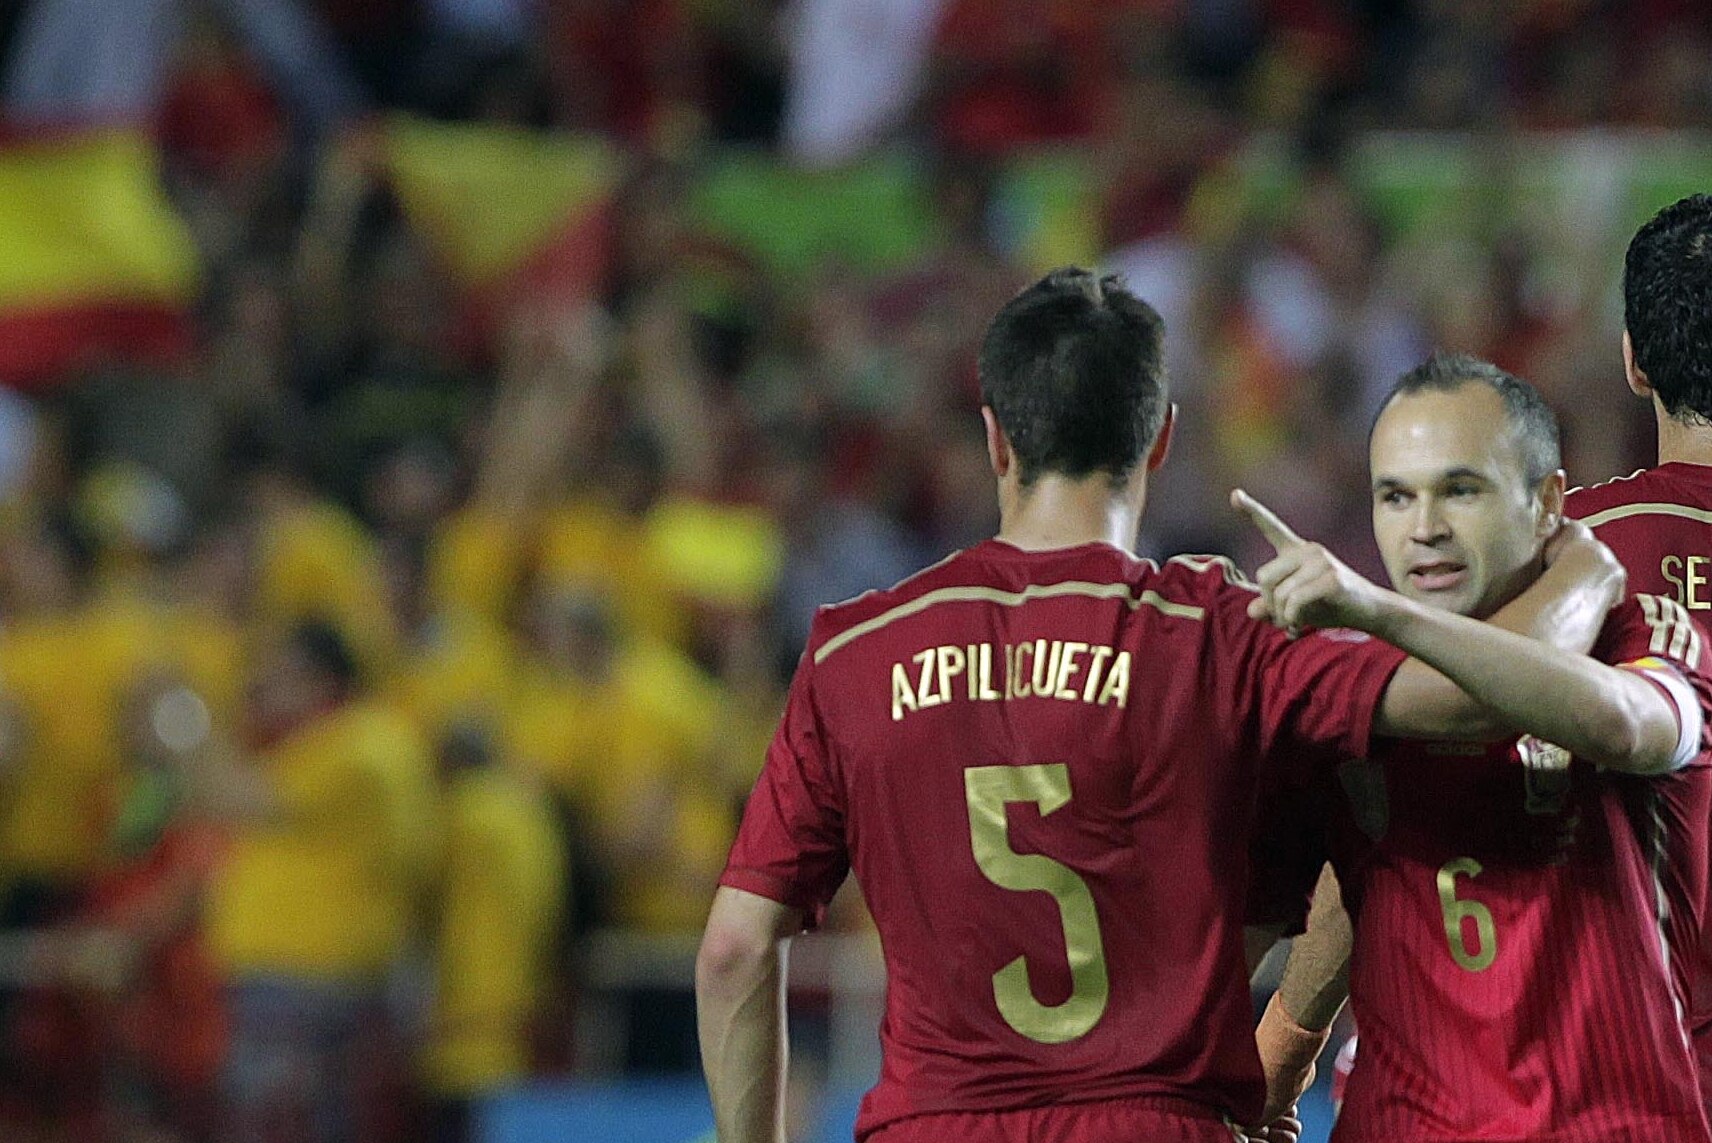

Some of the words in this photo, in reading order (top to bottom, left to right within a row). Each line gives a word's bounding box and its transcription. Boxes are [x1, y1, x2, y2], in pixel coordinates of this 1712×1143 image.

[891, 638, 1132, 721] AZPILICUETA
[964, 763, 1109, 1045] 5
[1436, 857, 1497, 971] 6
